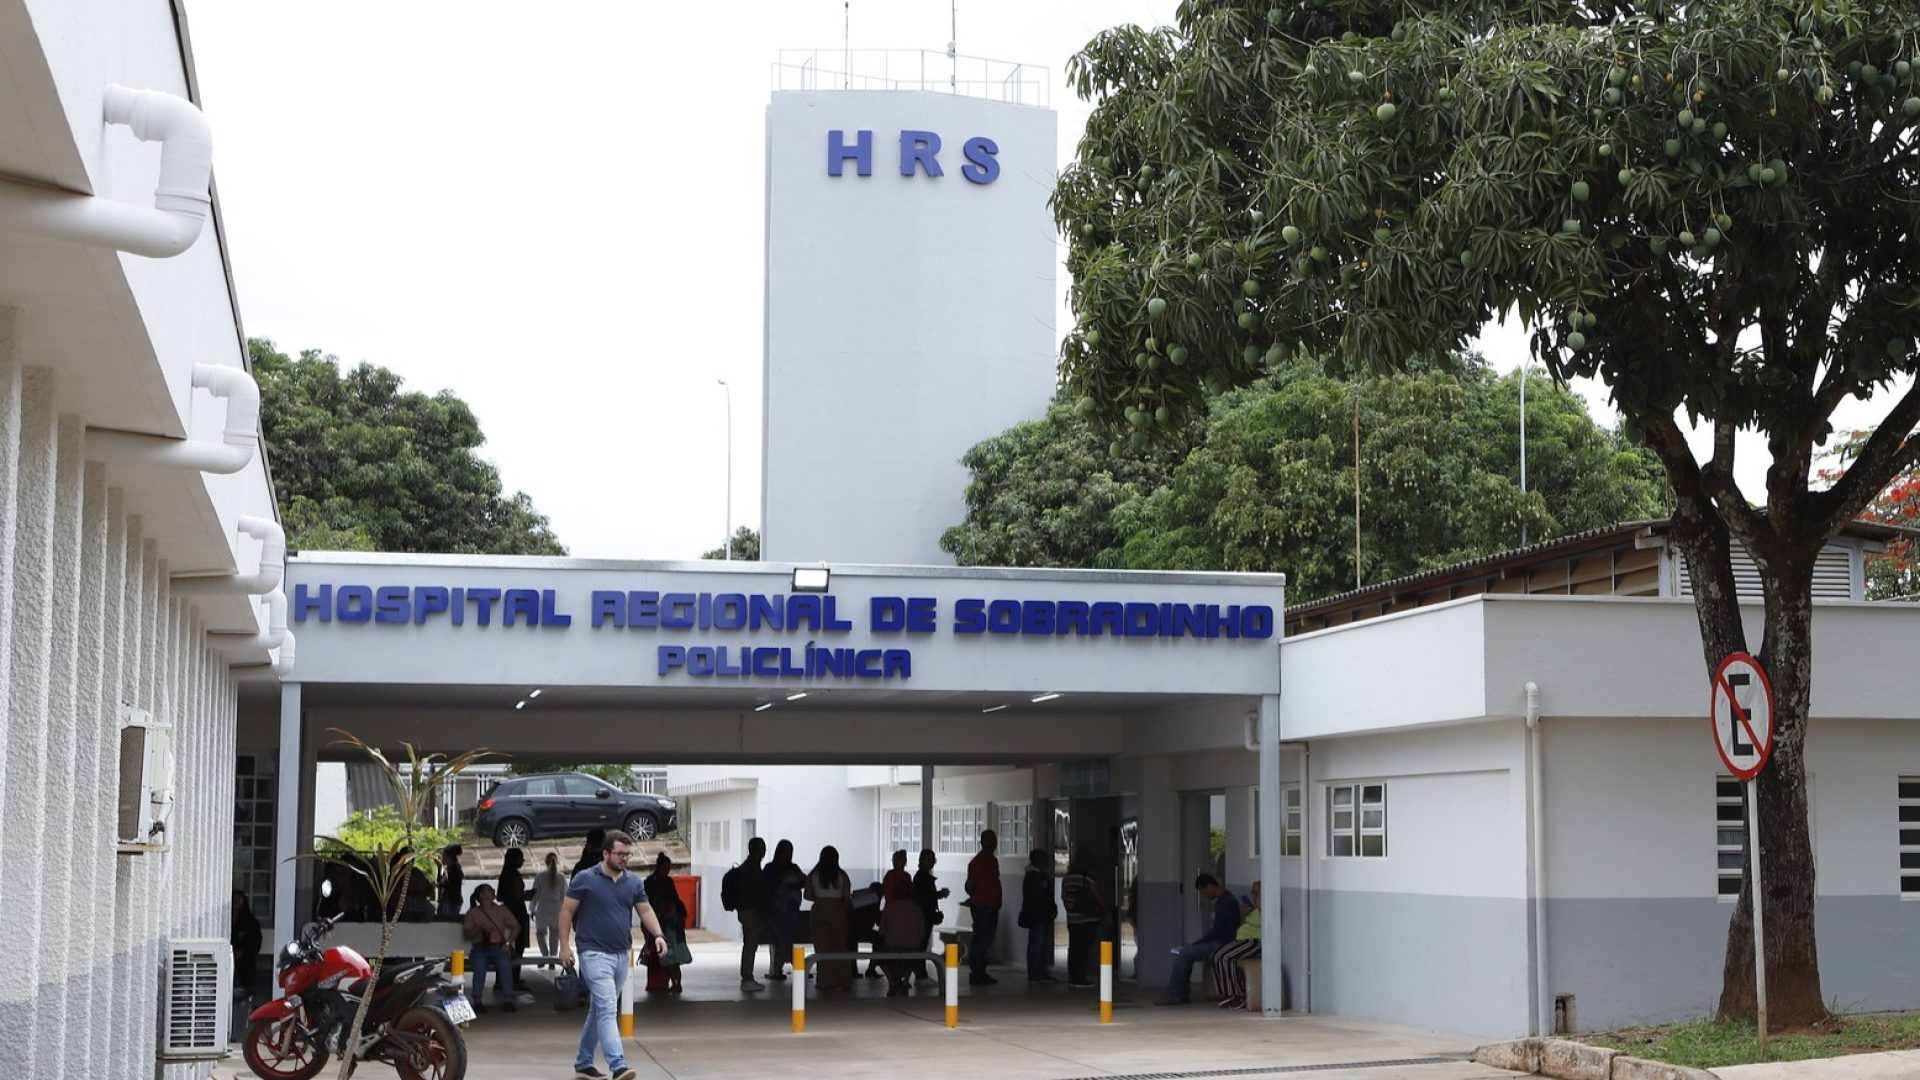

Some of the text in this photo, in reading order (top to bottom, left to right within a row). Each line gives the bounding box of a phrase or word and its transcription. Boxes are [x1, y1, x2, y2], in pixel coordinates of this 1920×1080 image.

[295, 584, 1274, 639] HOSPITAL REGIONAL DE SOBRADINHO
[658, 641, 912, 678] POLICLÍNICA
[1728, 673, 1754, 756] E
